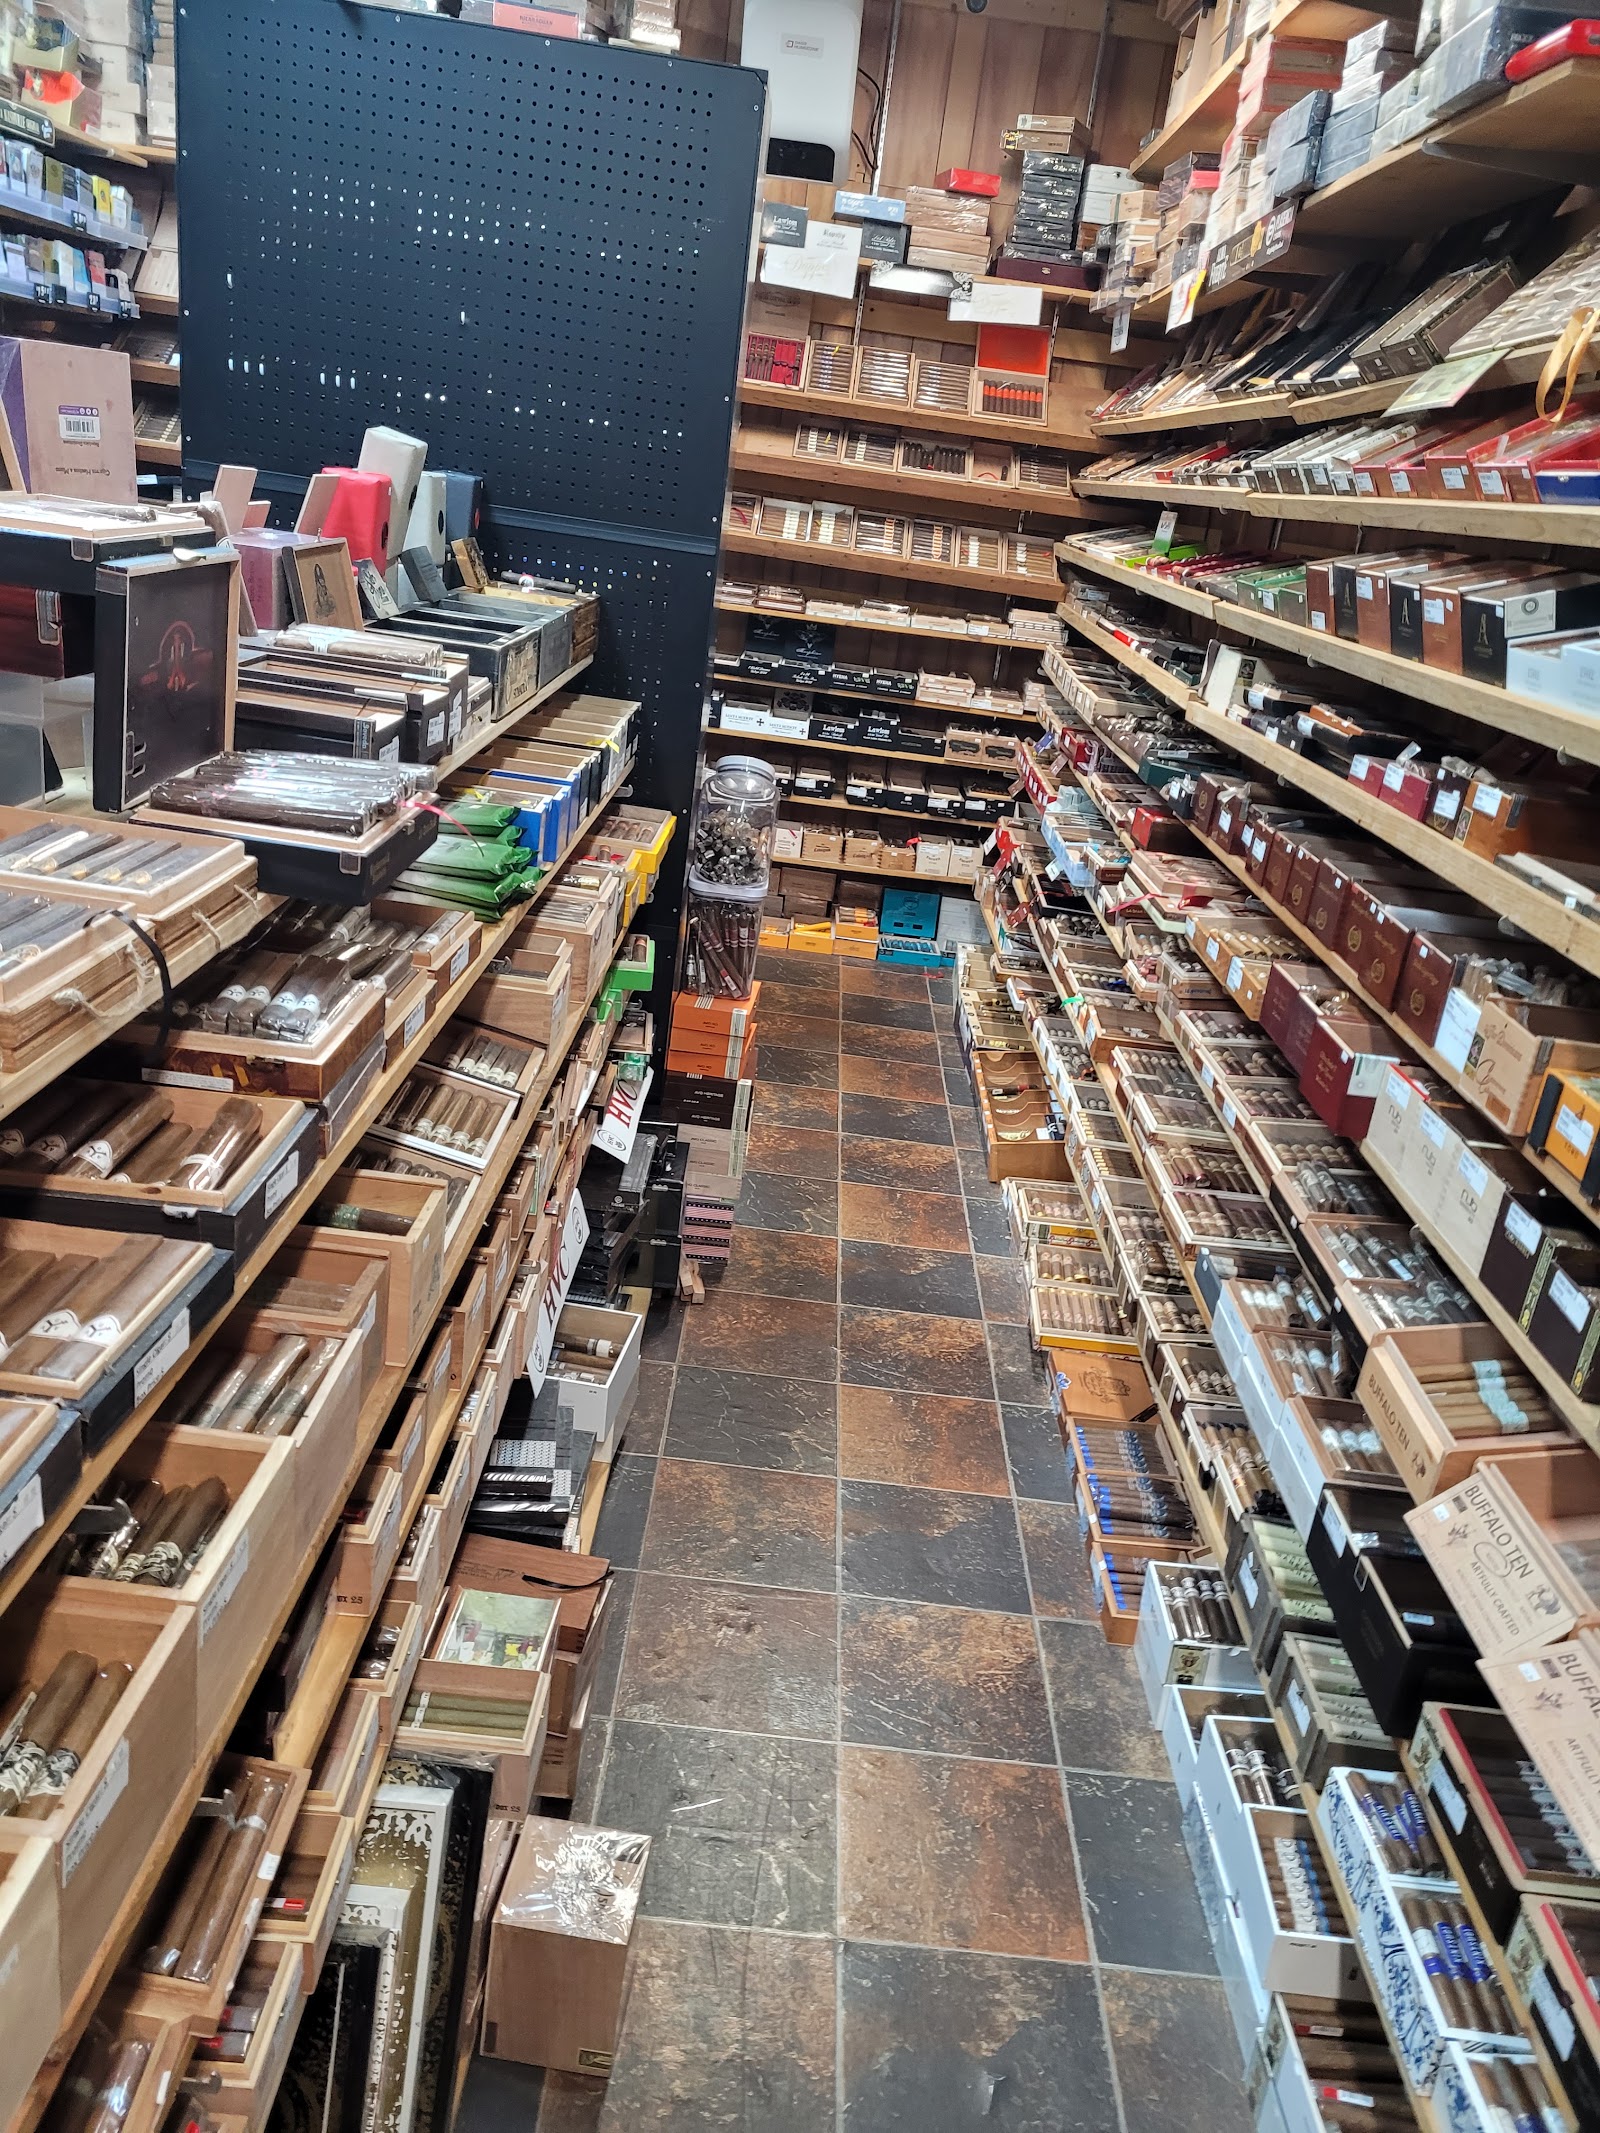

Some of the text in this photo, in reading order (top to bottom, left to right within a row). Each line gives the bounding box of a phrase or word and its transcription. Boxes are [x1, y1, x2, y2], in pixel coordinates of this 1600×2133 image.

[608, 1078, 638, 1129] HVC
[1388, 1104, 1402, 1125] nub
[1421, 1144, 1436, 1167] nub
[1460, 1188, 1478, 1213] nub
[542, 1246, 569, 1327] HVC
[1366, 1373, 1412, 1450] BUFFALO TEN
[1463, 1484, 1514, 1548] BUFFALO
[1503, 1544, 1534, 1579] TEN
[1468, 1559, 1497, 1598] ARTFULLY
[1492, 1598, 1520, 1637] CRAFTED
[1557, 1653, 1600, 1719] BUFFAL
